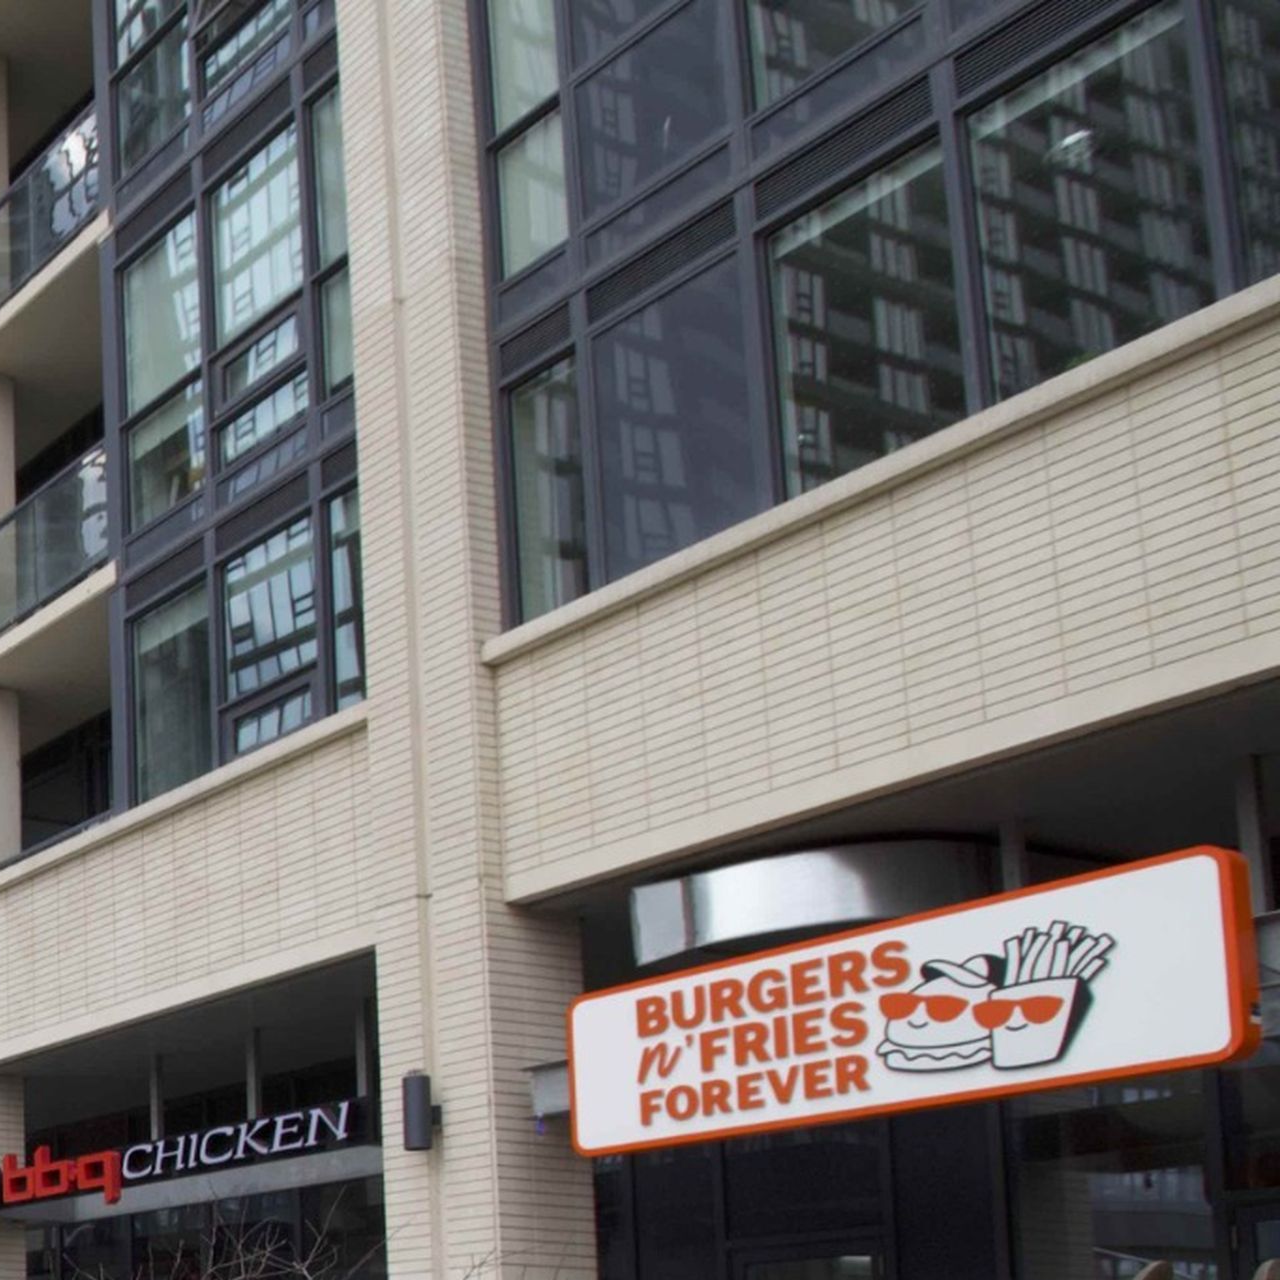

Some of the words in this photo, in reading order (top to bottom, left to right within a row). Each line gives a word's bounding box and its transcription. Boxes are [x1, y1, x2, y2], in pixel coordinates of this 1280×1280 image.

[635, 940, 911, 1038] BURGERS
[639, 1054, 870, 1127] FOREVER
[122, 1101, 351, 1181] CHICKEN
